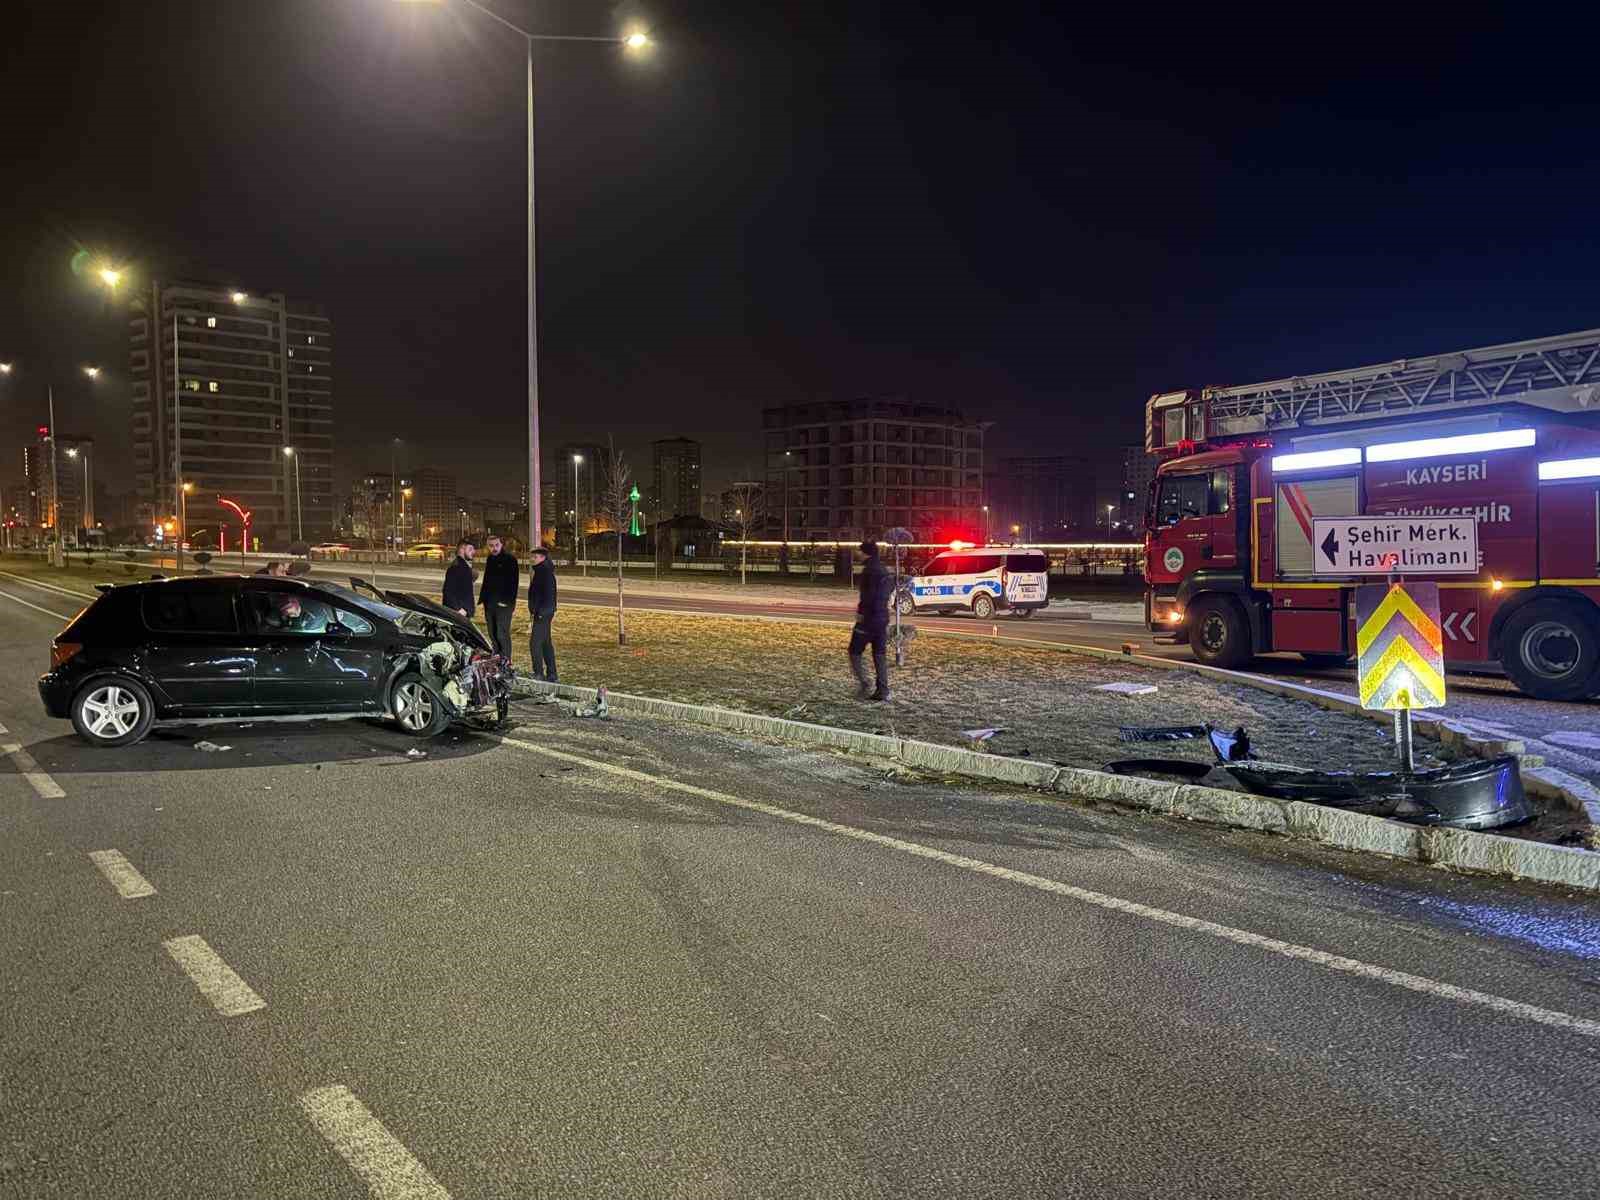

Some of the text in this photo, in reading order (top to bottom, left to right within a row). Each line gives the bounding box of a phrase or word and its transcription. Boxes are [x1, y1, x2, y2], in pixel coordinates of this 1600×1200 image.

[1406, 459, 1487, 485] KAYSERİ
[1348, 523, 1467, 547] Şehir Merk.
[1349, 549, 1467, 567] Havalimanı
